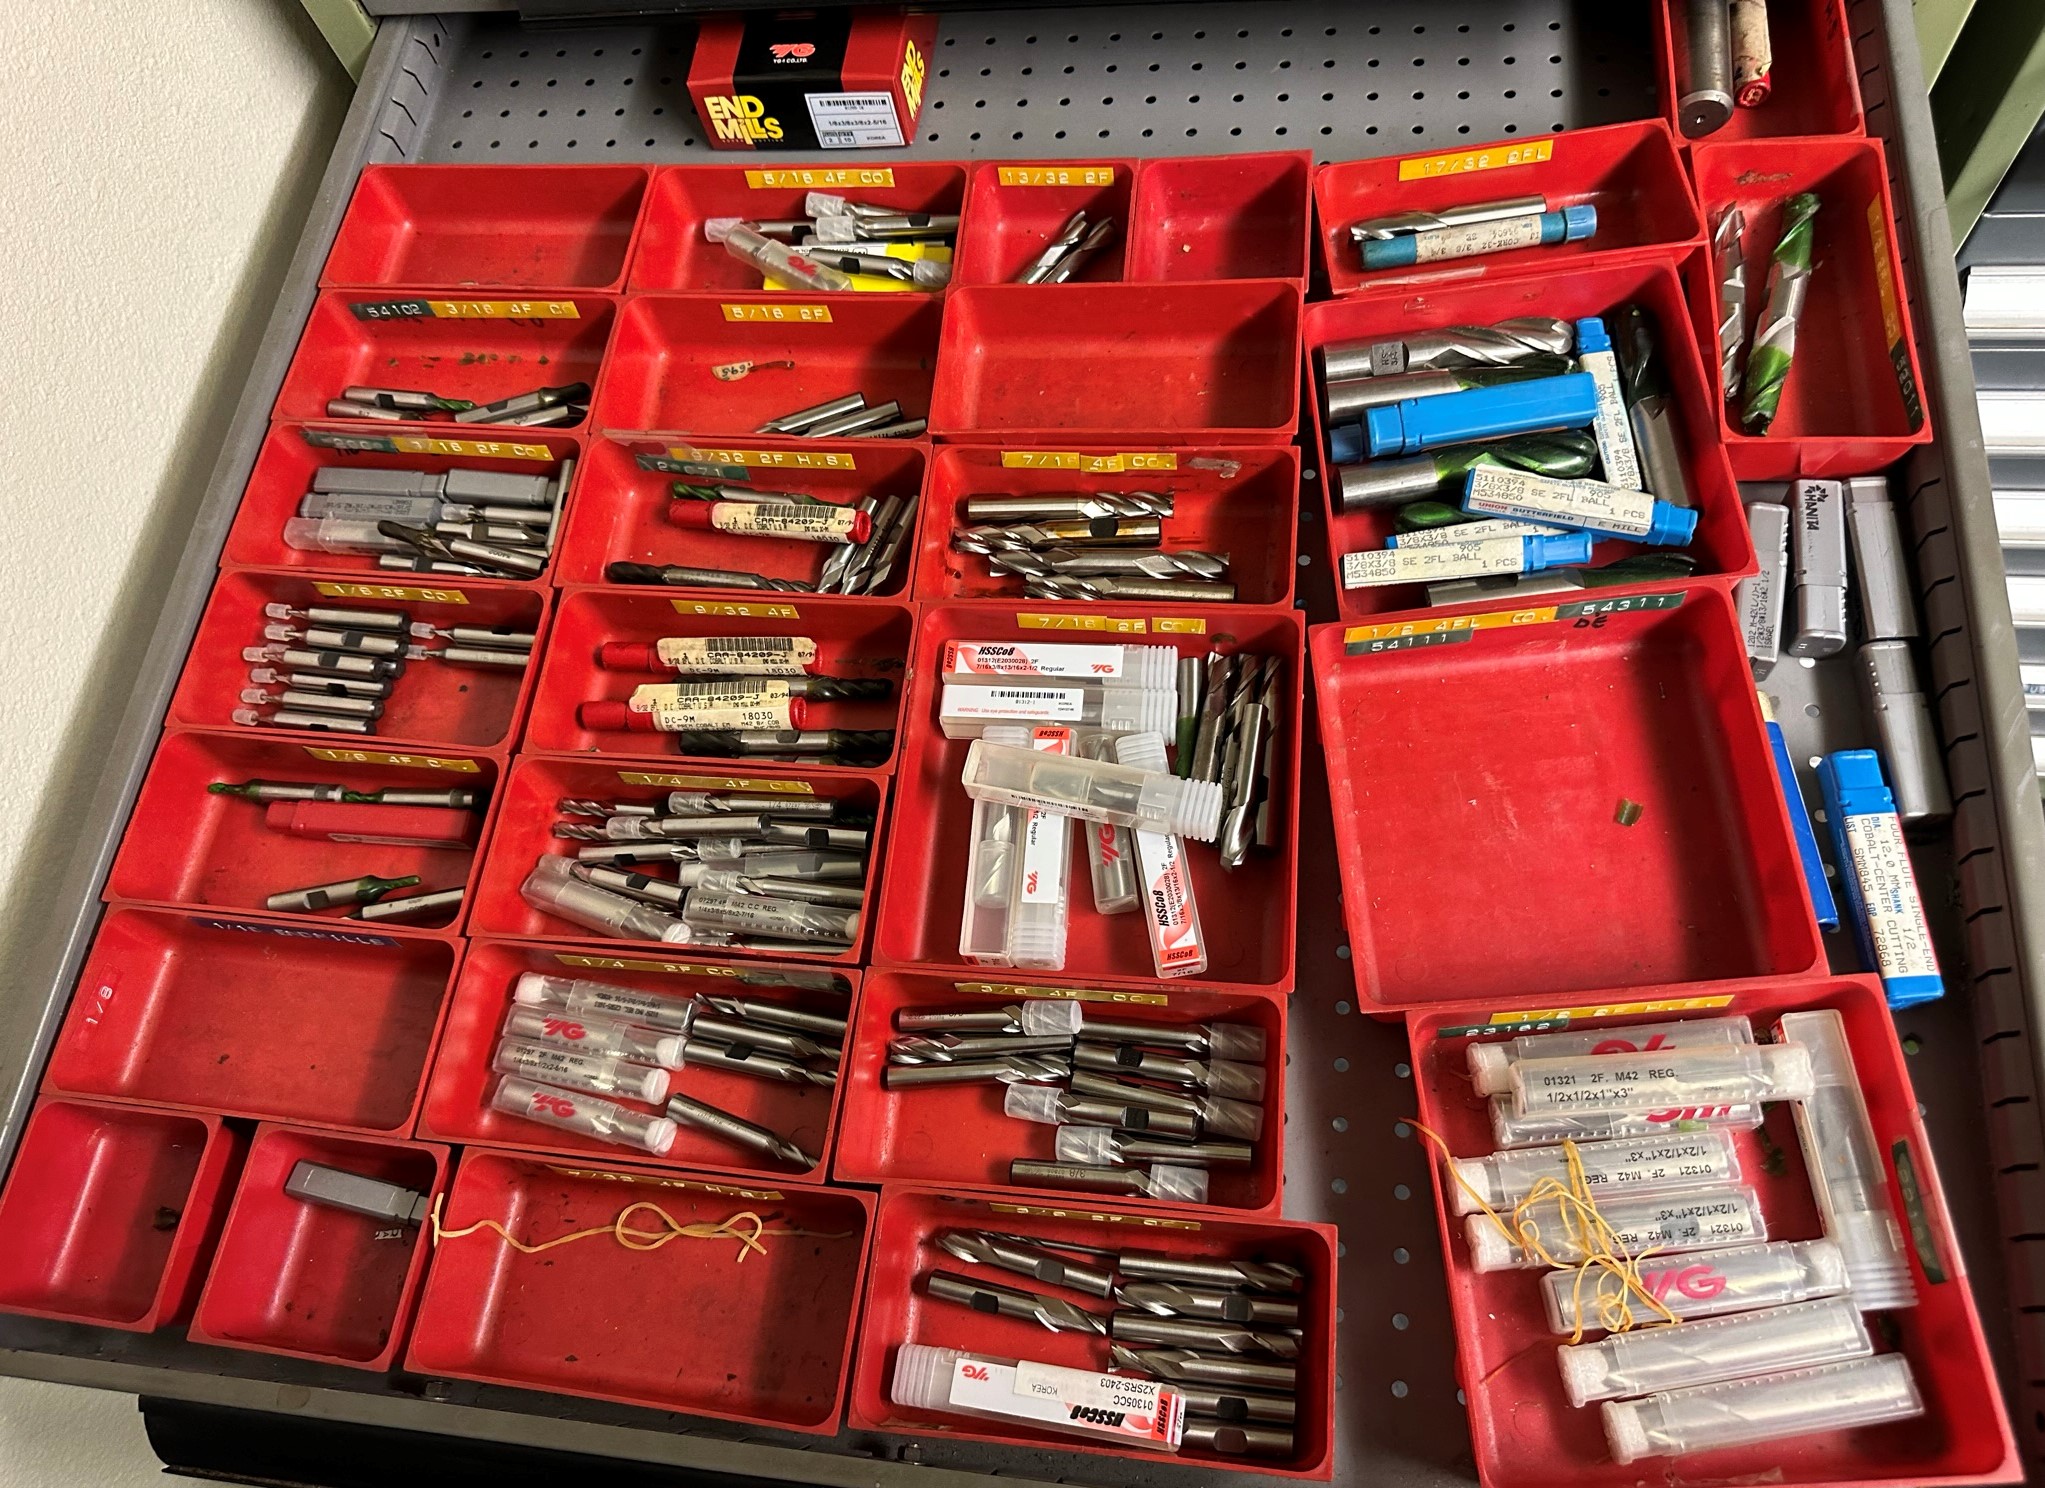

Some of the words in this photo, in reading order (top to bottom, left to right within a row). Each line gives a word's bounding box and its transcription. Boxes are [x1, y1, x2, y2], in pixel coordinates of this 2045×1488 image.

[703, 95, 765, 120] END
[712, 117, 784, 145] MILLS
[1423, 154, 1490, 174] 17/32
[1506, 148, 1548, 165] 2FL
[763, 172, 813, 185] 5/16
[825, 172, 847, 184] 4F
[1006, 171, 1069, 184] 13/32
[1085, 172, 1108, 185] 2F
[367, 303, 423, 318] 54102
[447, 303, 496, 315] 3/16
[510, 303, 532, 314] 4F
[732, 306, 784, 320] 5/16
[800, 307, 824, 321] 2F
[1605, 385, 1618, 405] BALL
[1613, 409, 1624, 427] 2FL
[1617, 432, 1628, 444] SE
[478, 443, 499, 454] 2F
[760, 453, 783, 464] 2F
[797, 454, 850, 467] H.S.
[1021, 455, 1078, 467] 7/16
[1091, 457, 1118, 470] 4F
[1474, 481, 1525, 495] 3/8X3/8
[1530, 489, 1546, 498] SE
[1552, 491, 1574, 502] 2FL
[1581, 496, 1611, 508] BALL
[1475, 473, 1526, 487] 5110394
[1588, 489, 1612, 499] 905
[1472, 488, 1524, 502] M534850
[1478, 502, 1508, 511] UNION
[1511, 507, 1575, 522] BUTTERFIELD
[1611, 523, 1642, 533] MILL
[1804, 493, 1820, 531] HANITA
[1399, 532, 1449, 546] 3/8X3/8
[1453, 528, 1469, 538] SE
[1475, 525, 1497, 535] 2FL
[1346, 550, 1395, 562] 5110394
[1459, 543, 1481, 552] 905
[1346, 559, 1397, 569] 3/8X3/8
[1402, 557, 1418, 566] SE
[1424, 555, 1446, 564] 2FL
[1452, 552, 1482, 563] BALL
[1346, 568, 1396, 579] M534850
[1482, 560, 1488, 568] 1
[1495, 558, 1518, 568] PCS
[381, 588, 404, 598] 2F
[695, 604, 749, 616] 9/32
[768, 607, 792, 618] 4F
[1581, 596, 1666, 616] 54311
[1037, 617, 1098, 630] 7/16
[1116, 621, 1146, 633] 2F
[1371, 624, 1414, 639] 1/2
[1434, 616, 1481, 632] 4FL
[1370, 633, 1449, 653] 54111
[1763, 624, 1775, 649] ISRAEL
[978, 646, 1016, 656] HSSCo8
[1040, 665, 1065, 673] Regular
[676, 694, 760, 704] CAA-84209-J
[664, 715, 696, 724] DC-9M
[742, 711, 773, 721] 18030
[389, 755, 411, 765] 4F
[643, 774, 682, 787] 1/4
[726, 780, 750, 789] 4F
[1029, 821, 1038, 846] Regular
[1164, 834, 1174, 859] Regular
[1879, 839, 1896, 868] 12.0
[1160, 862, 1168, 871] 2F
[1889, 874, 1901, 889] MM
[1844, 816, 1857, 833] LIST
[1854, 847, 1874, 893] SMM845
[1873, 928, 1892, 967] 72868
[1153, 889, 1170, 927] HSSCo8
[1889, 889, 1904, 915] SHANK
[1886, 919, 1909, 974] CUTTING
[1902, 928, 1917, 950] 1/2
[1166, 949, 1194, 961] HSSCo8
[580, 957, 625, 968] 1/4
[664, 964, 692, 972] 2F
[1049, 990, 1078, 998] 4F
[85, 986, 113, 1025] 1/8
[541, 1017, 588, 1041] YG
[1543, 1074, 1577, 1088] 01321
[1590, 1073, 1609, 1085] 2F.
[1615, 1070, 1639, 1083] M42
[1648, 1067, 1679, 1080] REG.
[1546, 1087, 1634, 1103] 1/2x1/2x1"x3"
[531, 1091, 577, 1118] YG
[1625, 1145, 1708, 1163] 1/2x1/2x1"x3"
[1069, 1168, 1086, 1180] 3/8
[1617, 1169, 1642, 1182] M42
[1647, 1167, 1666, 1179] 2F.
[1679, 1163, 1712, 1176] 01321
[1655, 1204, 1740, 1222] 1/2x1/2x1"x3"
[1648, 1227, 1673, 1240] M42
[1680, 1225, 1697, 1237] 2F.
[1710, 1222, 1744, 1235] 01321
[960, 1365, 991, 1382] YG
[1031, 1382, 1058, 1395] KOREA
[1100, 1377, 1155, 1396] X2SRS-2403
[1113, 1394, 1154, 1411] 01305CC
[1156, 1398, 1169, 1436] HSSCo8
